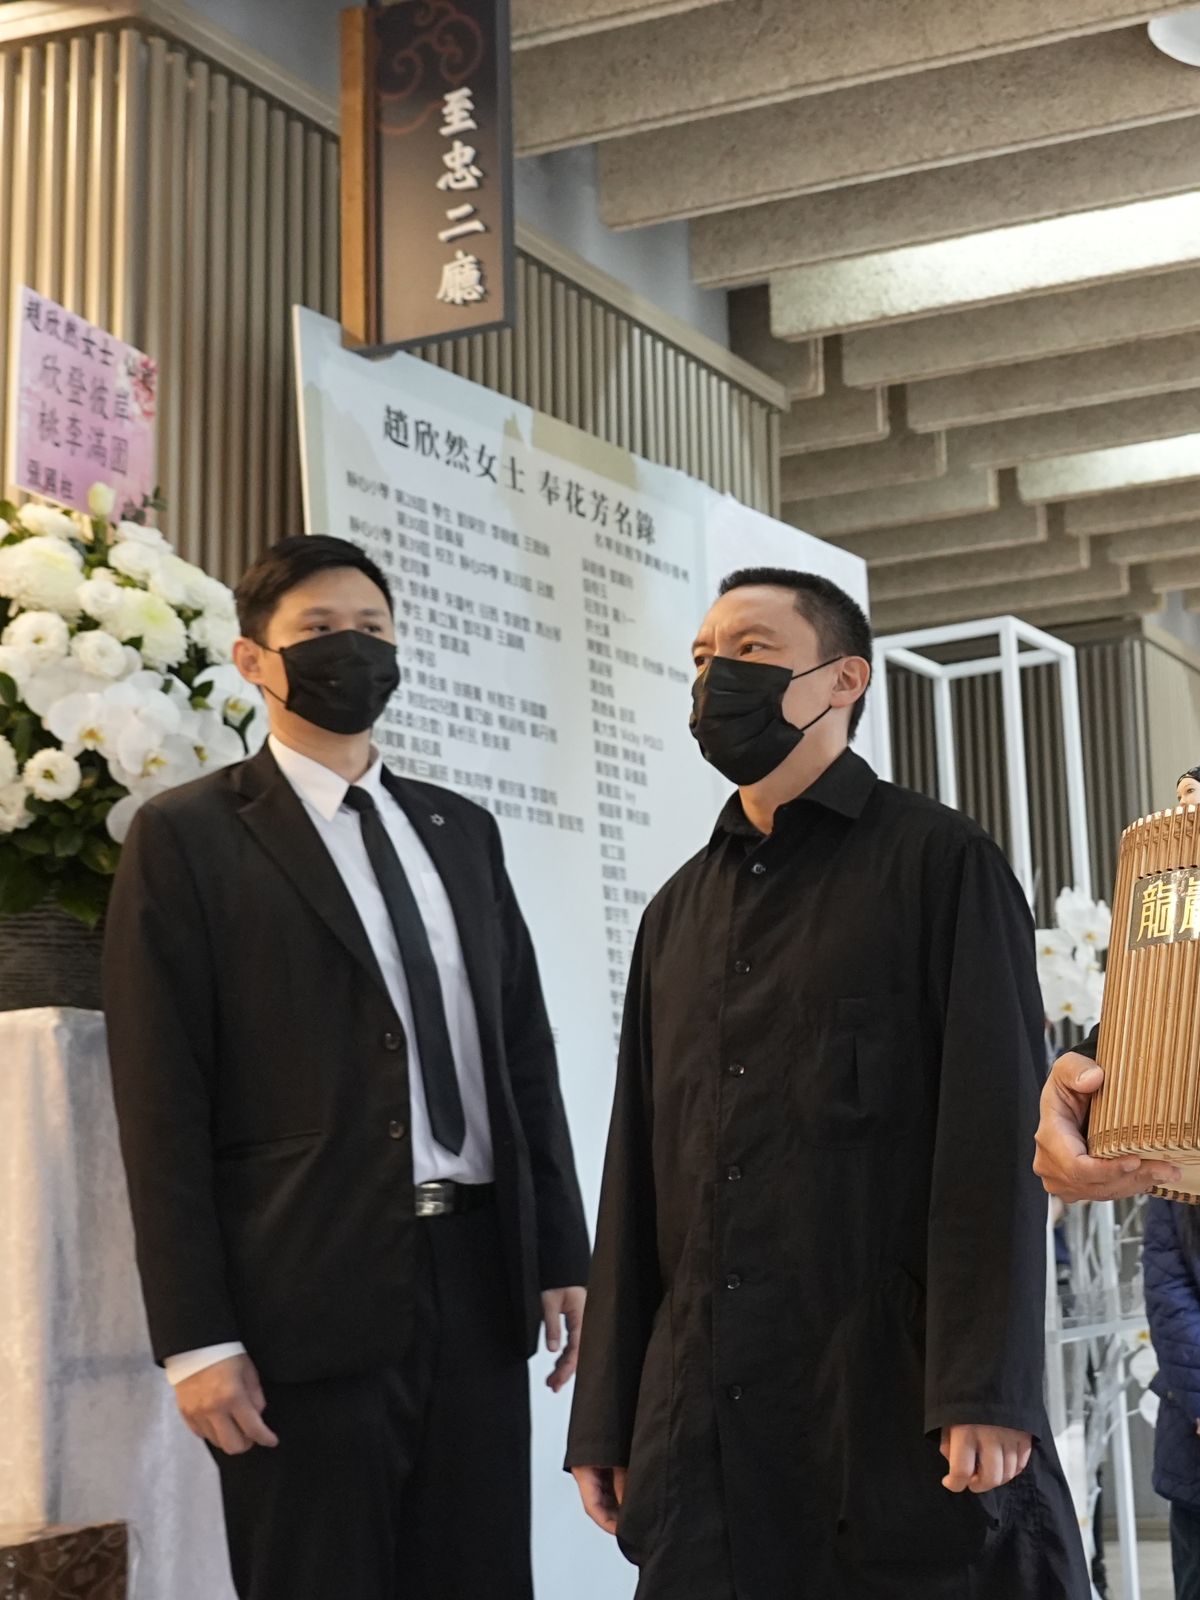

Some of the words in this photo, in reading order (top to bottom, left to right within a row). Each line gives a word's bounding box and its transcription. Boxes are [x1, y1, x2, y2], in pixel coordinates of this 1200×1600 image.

[436, 86, 486, 306] 至忠二廳
[384, 404, 525, 494] 趙欣然女士
